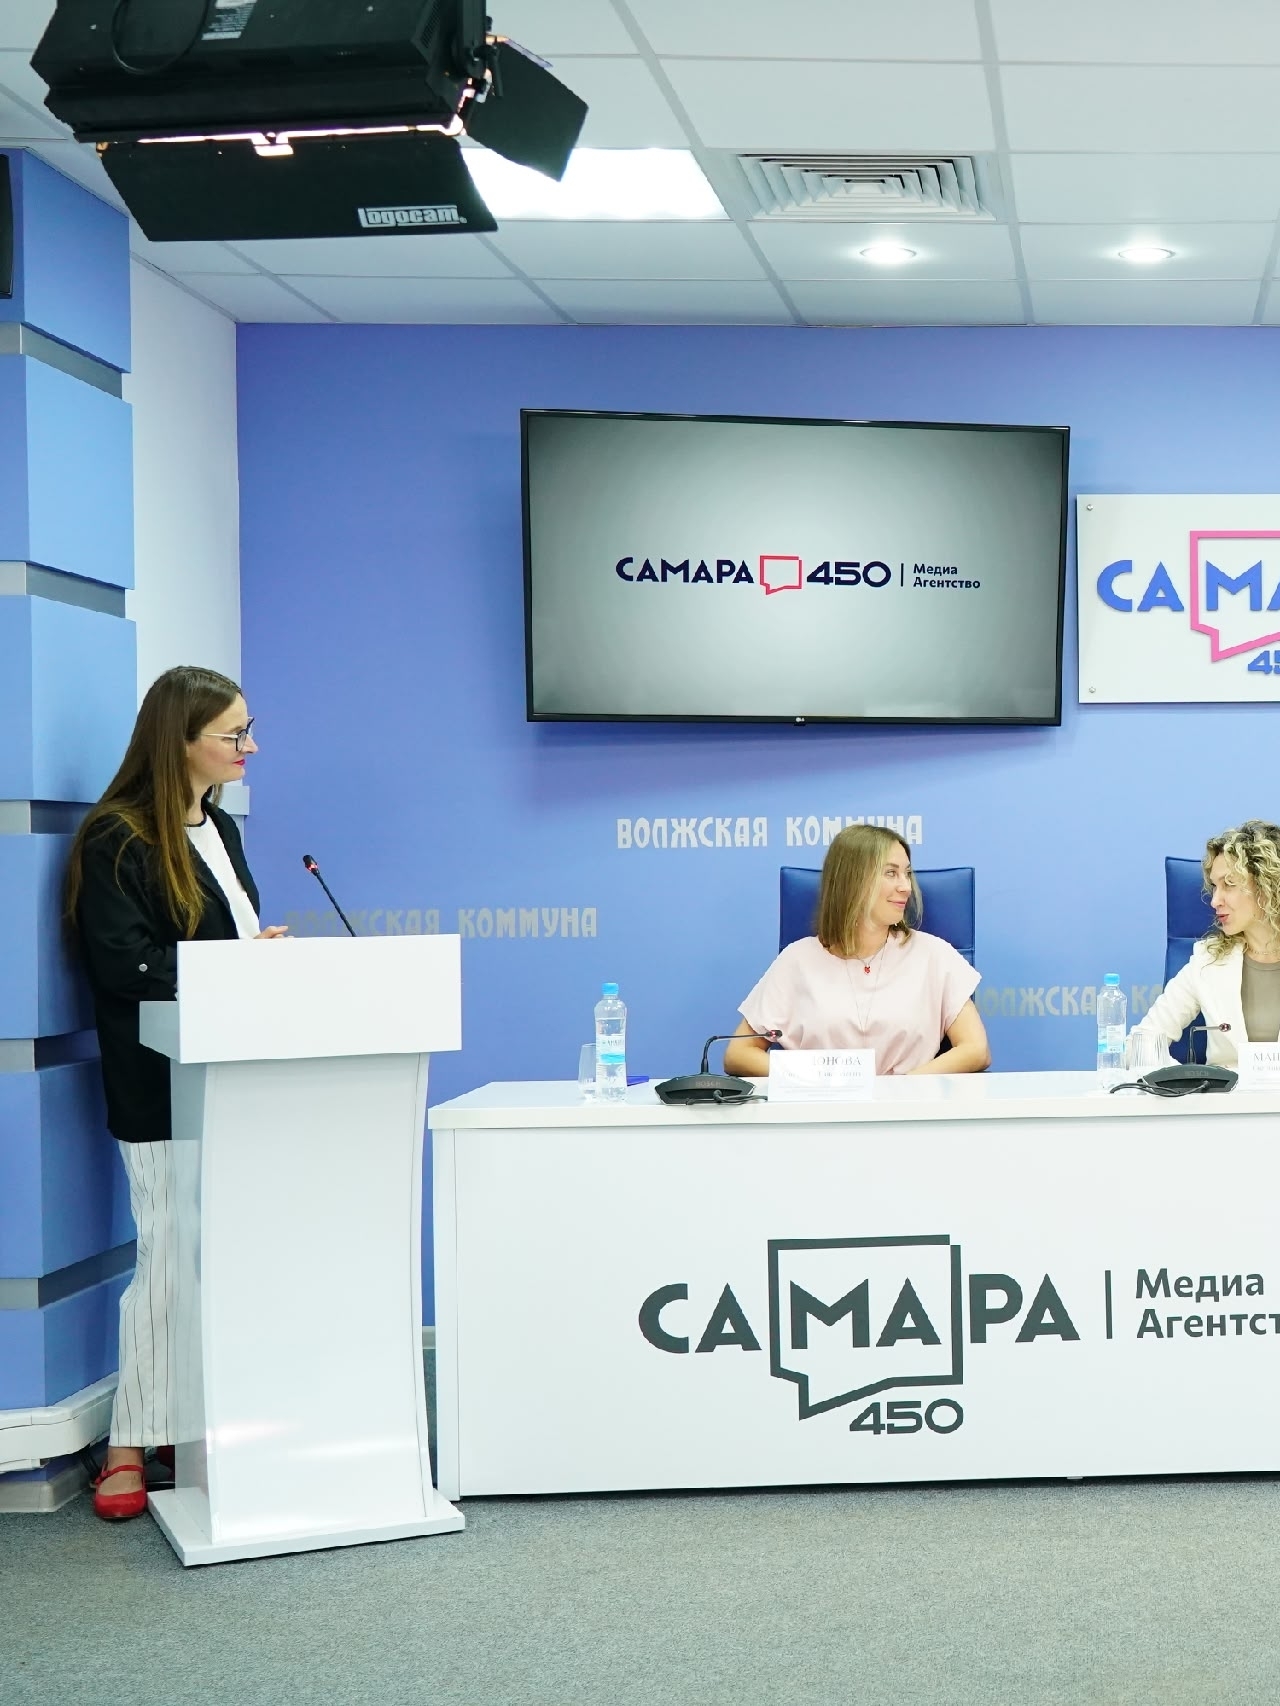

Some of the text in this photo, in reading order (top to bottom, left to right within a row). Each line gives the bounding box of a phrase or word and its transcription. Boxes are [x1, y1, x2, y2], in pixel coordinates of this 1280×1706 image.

[615, 556, 892, 588] САМАРА 450
[913, 563, 958, 576] Медиа
[913, 577, 981, 589] Агентство
[617, 817, 768, 848] ВОЛЖСКАЯ
[458, 907, 597, 938] КОММУНА
[1136, 1269, 1264, 1302] Медиа
[638, 1273, 1081, 1353] САМАРА
[849, 1398, 964, 1435] 450
